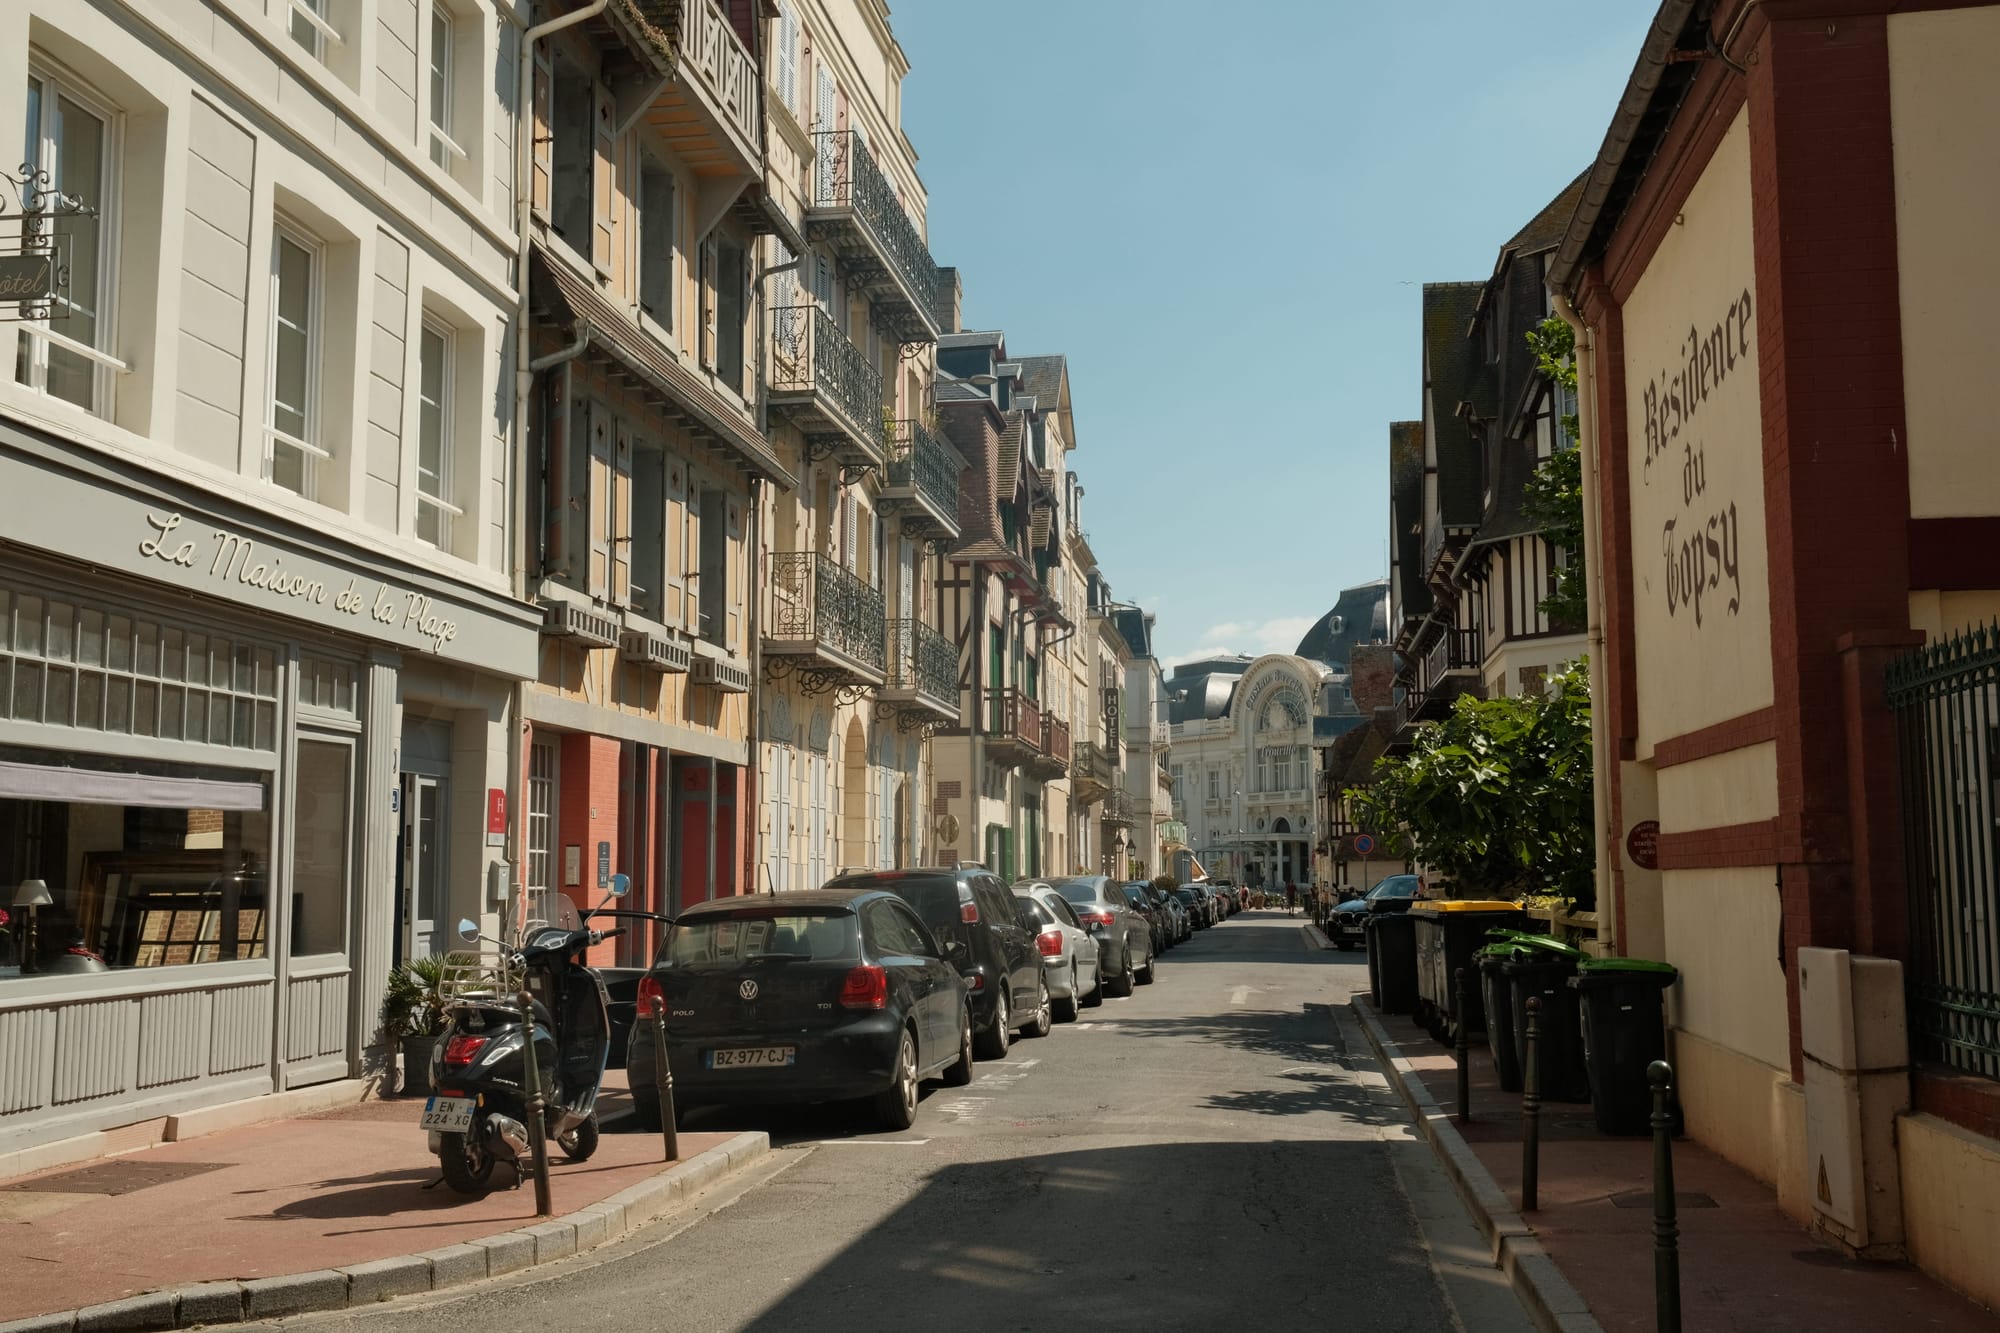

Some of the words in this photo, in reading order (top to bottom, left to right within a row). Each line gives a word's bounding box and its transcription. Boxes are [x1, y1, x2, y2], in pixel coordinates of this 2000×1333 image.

[0, 263, 48, 294] ôtel
[1643, 287, 1752, 487] Résidence
[1683, 440, 1706, 508] du
[139, 512, 197, 568] La
[209, 529, 328, 605] Maison
[335, 578, 364, 615] de
[371, 582, 398, 625] la
[403, 591, 457, 655] Plage
[1662, 500, 1741, 630] Topsy
[1106, 695, 1118, 749] HOTEL
[497, 797, 504, 813] H
[672, 1009, 695, 1017] POLO
